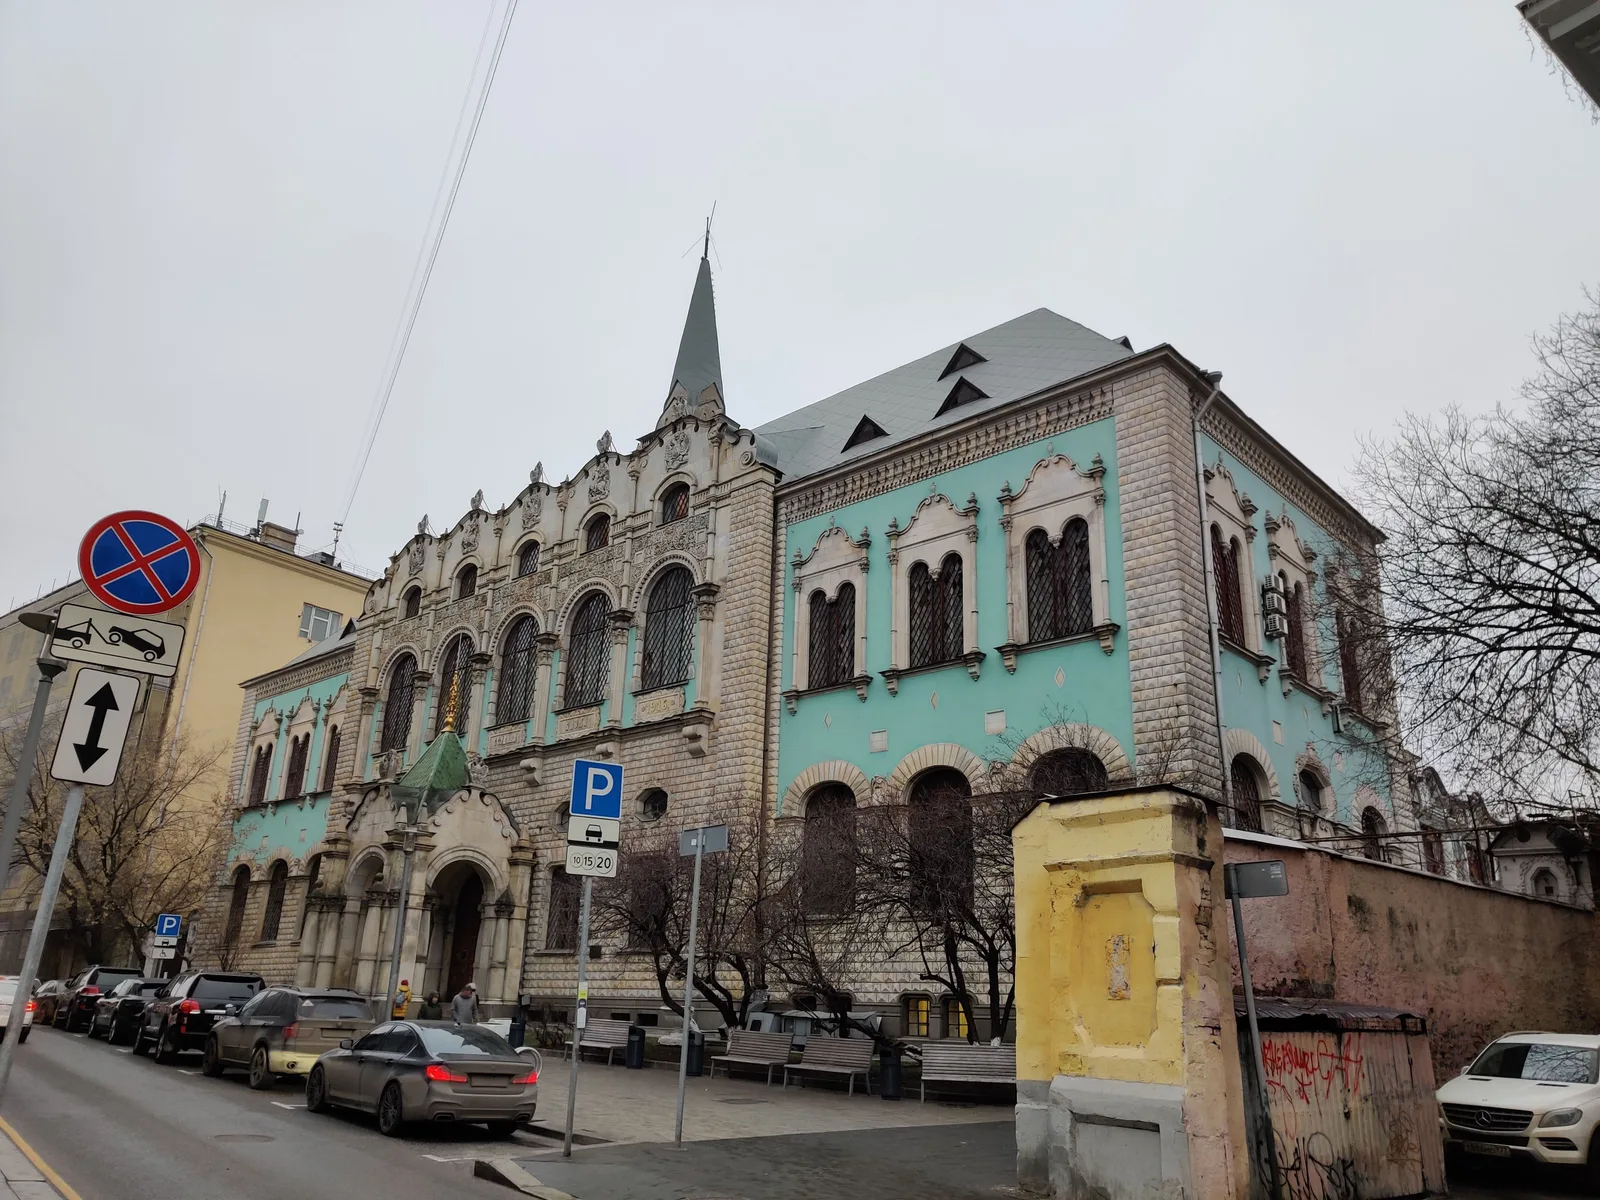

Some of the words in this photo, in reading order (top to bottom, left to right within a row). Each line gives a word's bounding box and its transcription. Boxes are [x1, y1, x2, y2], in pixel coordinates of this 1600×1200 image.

[585, 767, 614, 810] P
[573, 856, 581, 865] 10
[584, 856, 593, 867] 15
[596, 856, 612, 869] 20
[163, 917, 176, 933] P
